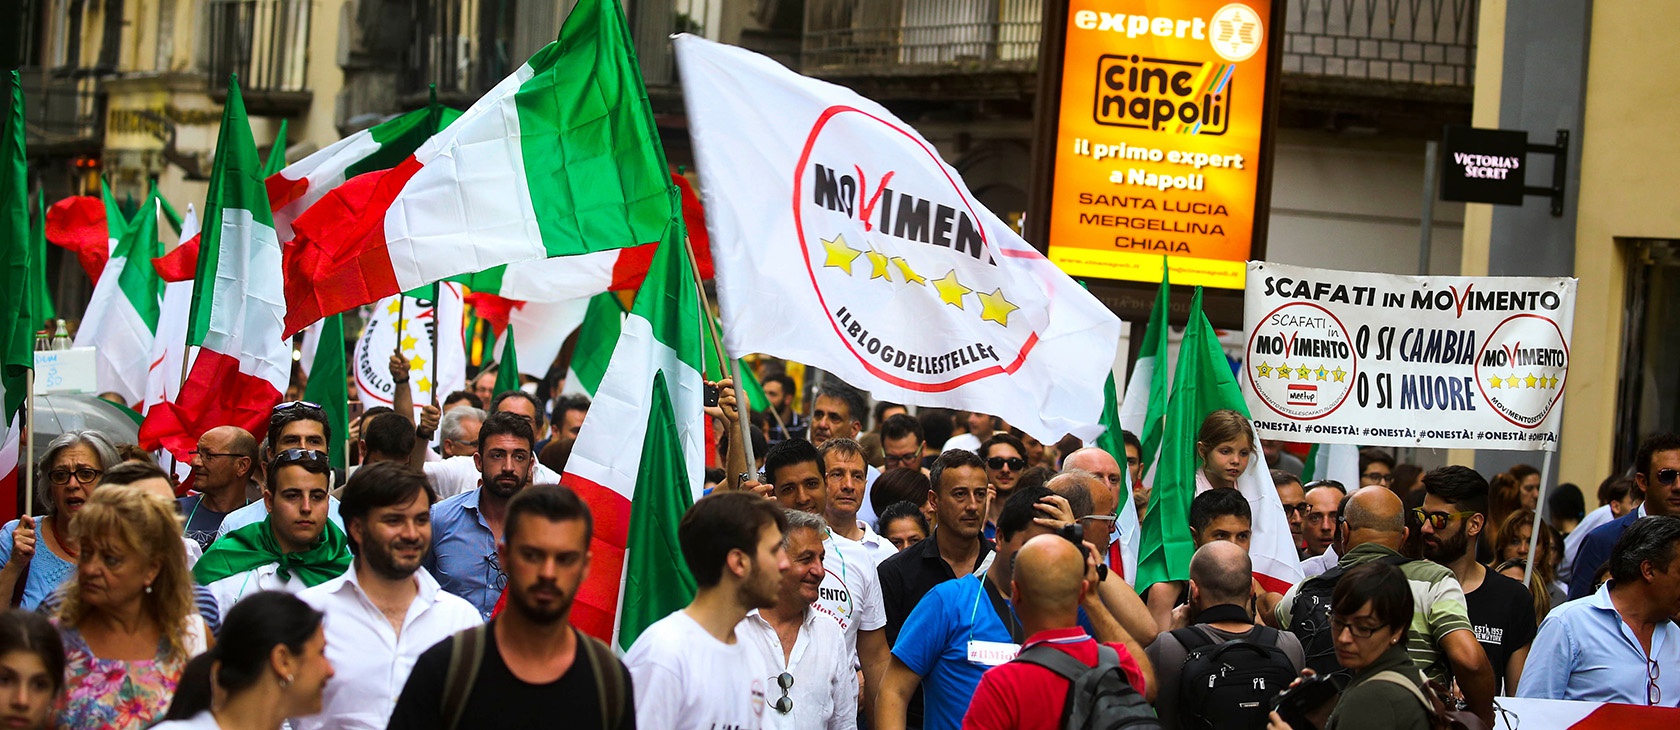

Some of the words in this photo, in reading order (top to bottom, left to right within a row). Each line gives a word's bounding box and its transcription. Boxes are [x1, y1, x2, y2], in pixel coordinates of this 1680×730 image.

[1074, 9, 1206, 41] expert
[1104, 54, 1193, 97] cine
[1101, 93, 1222, 131] napoli
[1074, 138, 1090, 156] il
[1093, 141, 1164, 163] primo
[1166, 149, 1245, 170] expert
[1453, 151, 1520, 170] VICTORIA'S
[1109, 169, 1124, 184] a
[1127, 168, 1205, 191] Napoli
[1464, 165, 1509, 180] SECRET
[814, 163, 998, 267] MOVIMEN
[1078, 192, 1158, 211] SANTA
[1162, 200, 1229, 217] LUCIA
[1079, 213, 1226, 237] MERGELLINA
[1114, 236, 1191, 254] CHIAIA
[1263, 276, 1377, 307] SCAFATI
[1382, 292, 1406, 309] IN
[1410, 282, 1561, 319] MOVIMENTO
[1271, 313, 1326, 329] SCAFATI
[1327, 324, 1340, 338] in
[1255, 330, 1350, 360] MOVIMENTO
[1355, 324, 1370, 360] O
[1375, 326, 1396, 361] SI
[1399, 327, 1476, 366] CAMBIA
[1482, 340, 1565, 369] MOVIMENTO
[1289, 391, 1316, 402] meetup
[1356, 371, 1370, 409] O
[1376, 372, 1393, 410] SI
[1400, 374, 1477, 412] MUORE
[1253, 420, 1302, 433] ONESTÀ!
[1304, 423, 1360, 436] #ONESTÀ!
[1362, 426, 1416, 438] #ONESTÀ!
[1419, 428, 1474, 441] #ONESTÀ!
[1477, 429, 1527, 442] #ONESTÀ!
